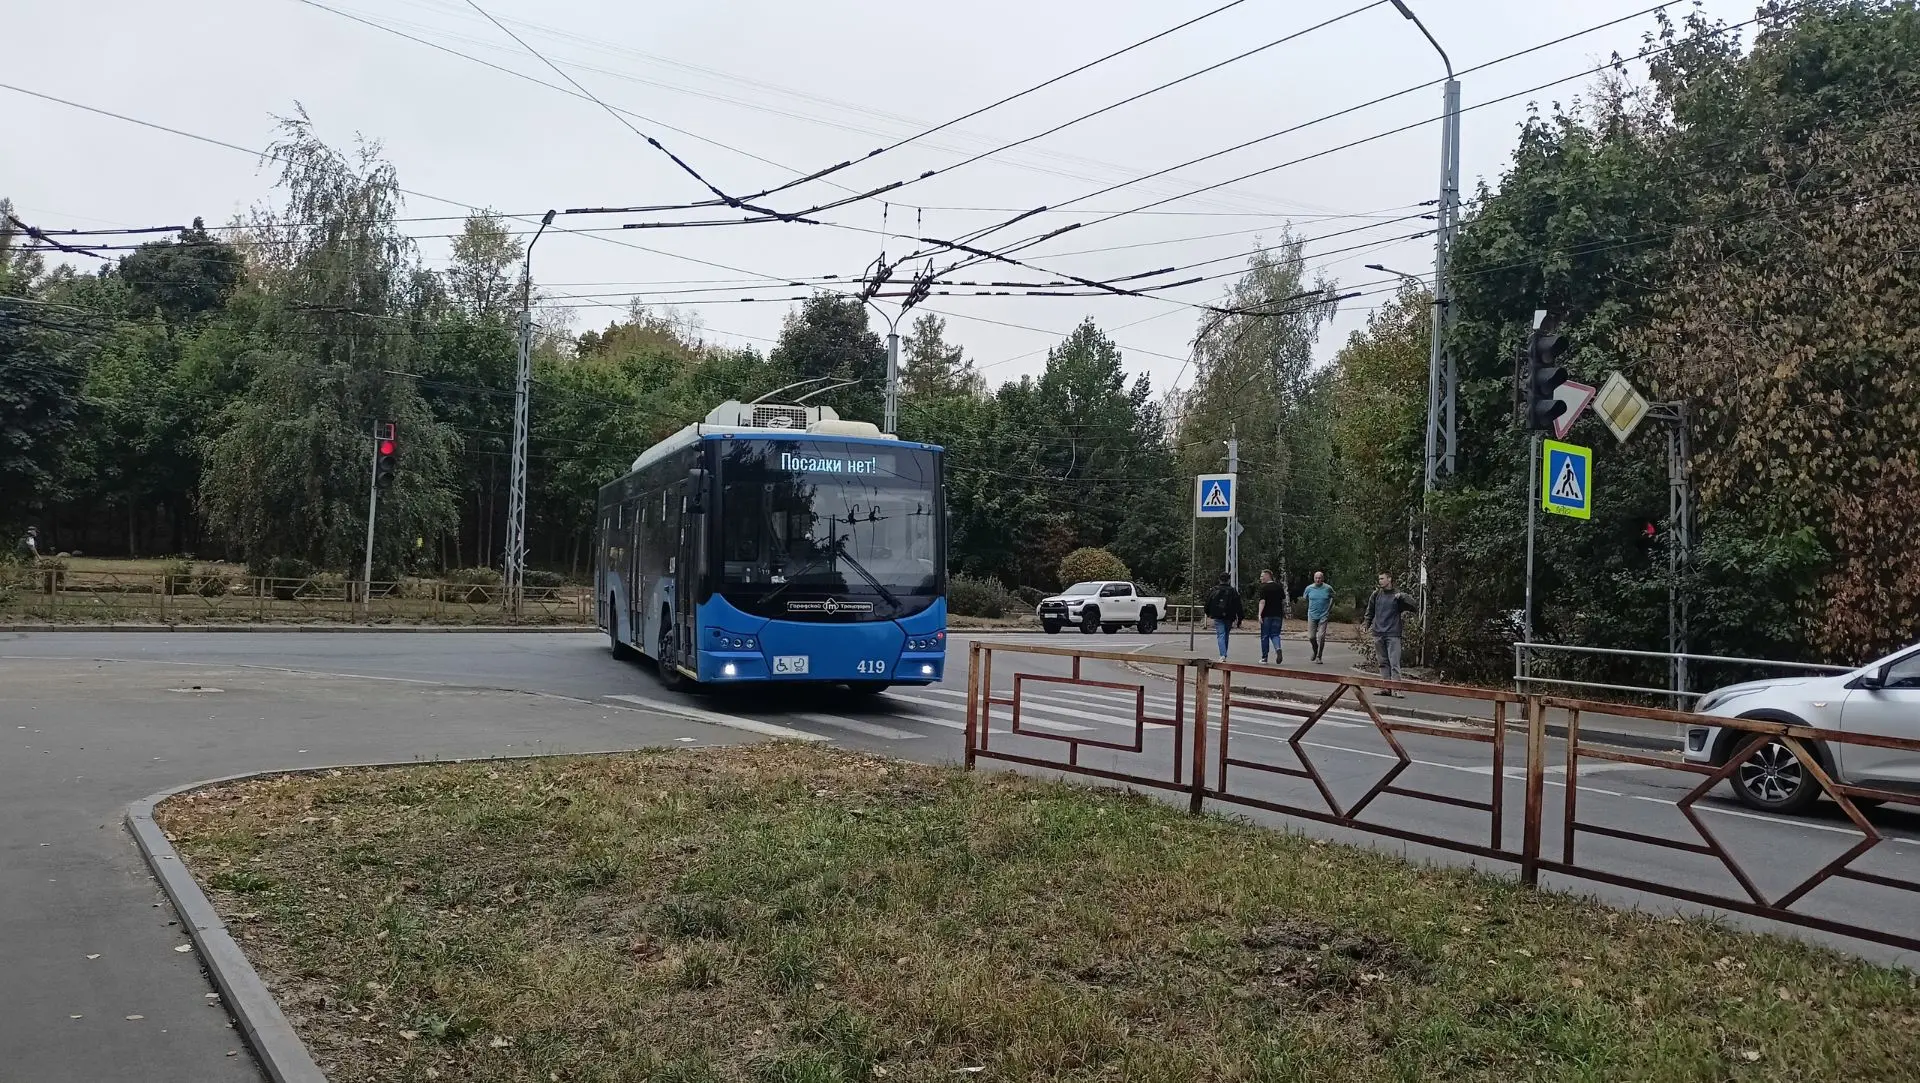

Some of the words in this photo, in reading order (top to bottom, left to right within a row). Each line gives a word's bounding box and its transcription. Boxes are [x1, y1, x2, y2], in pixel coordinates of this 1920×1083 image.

[781, 452, 842, 472] Посадки
[847, 456, 876, 474] нет!
[856, 659, 886, 674] 419
